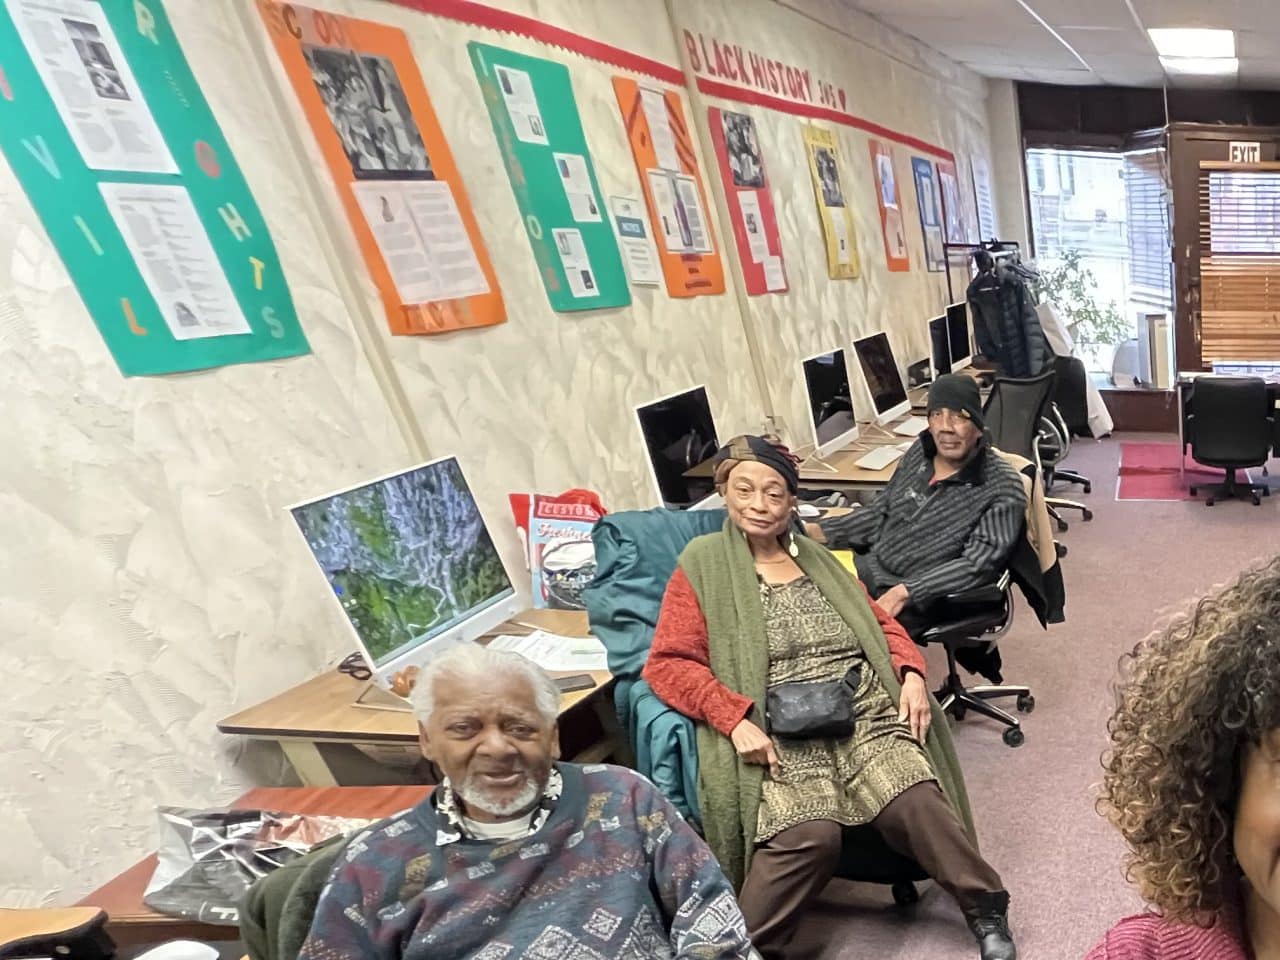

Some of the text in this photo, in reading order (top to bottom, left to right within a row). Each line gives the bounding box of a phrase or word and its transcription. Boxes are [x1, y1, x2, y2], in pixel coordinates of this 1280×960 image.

[683, 29, 751, 85] BLACK
[749, 51, 812, 101] HISTORY
[1232, 146, 1257, 163] EXIT
